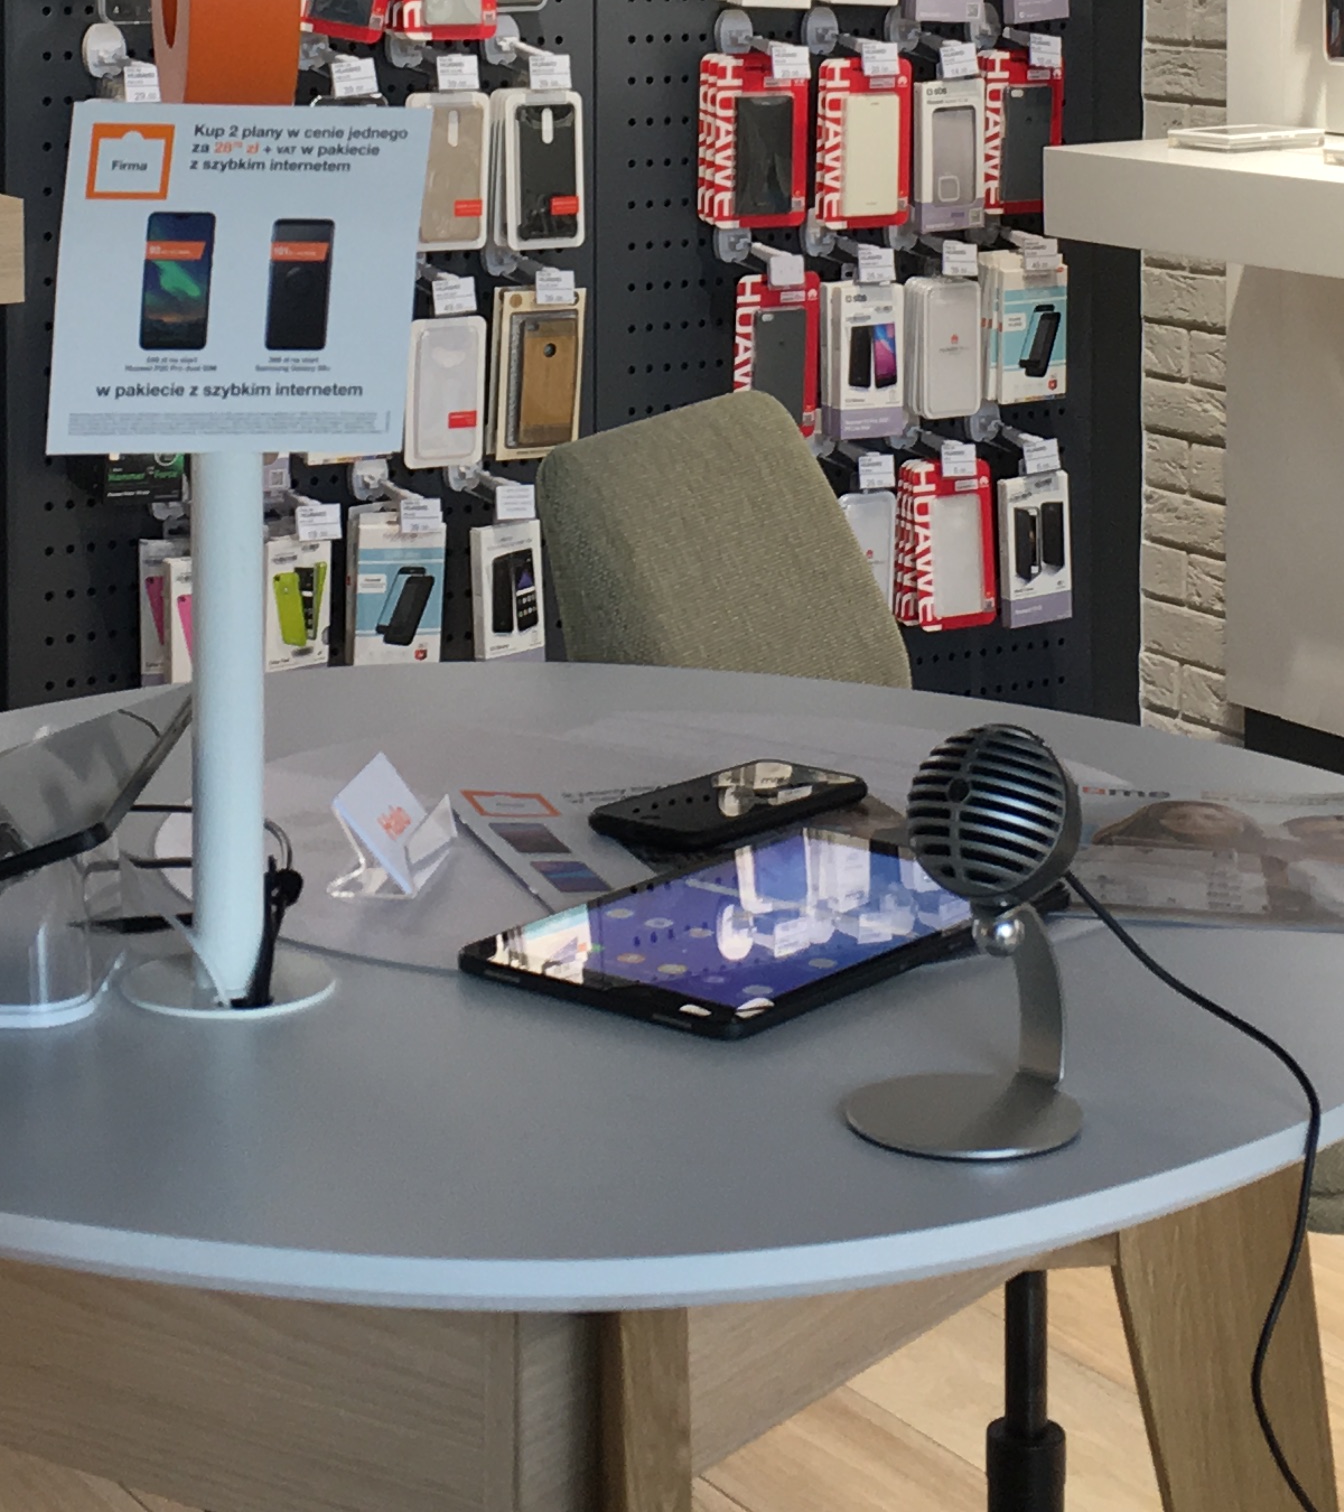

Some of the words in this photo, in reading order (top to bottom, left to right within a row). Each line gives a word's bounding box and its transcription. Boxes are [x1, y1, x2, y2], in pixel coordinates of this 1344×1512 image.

[194, 124, 226, 139] Kup
[229, 124, 239, 138] 2
[242, 124, 283, 140] plany
[288, 128, 301, 138] w
[304, 126, 345, 139] cenie
[347, 125, 410, 141] jednego
[192, 143, 210, 154] za
[277, 146, 298, 155] VAT
[302, 145, 314, 155] w
[318, 144, 381, 157] pakiecie
[714, 59, 745, 229] HUAWEI
[823, 59, 851, 230] HUAWEI
[111, 160, 148, 172] Firma
[190, 160, 199, 170] z
[203, 159, 266, 172] szybkim
[270, 159, 352, 172] internetem
[96, 385, 111, 397] w
[115, 383, 185, 400] pakiecie
[189, 386, 199, 397] z
[203, 384, 272, 400] szybkim
[275, 384, 364, 397] internetem
[914, 463, 943, 632] HUAWEI
